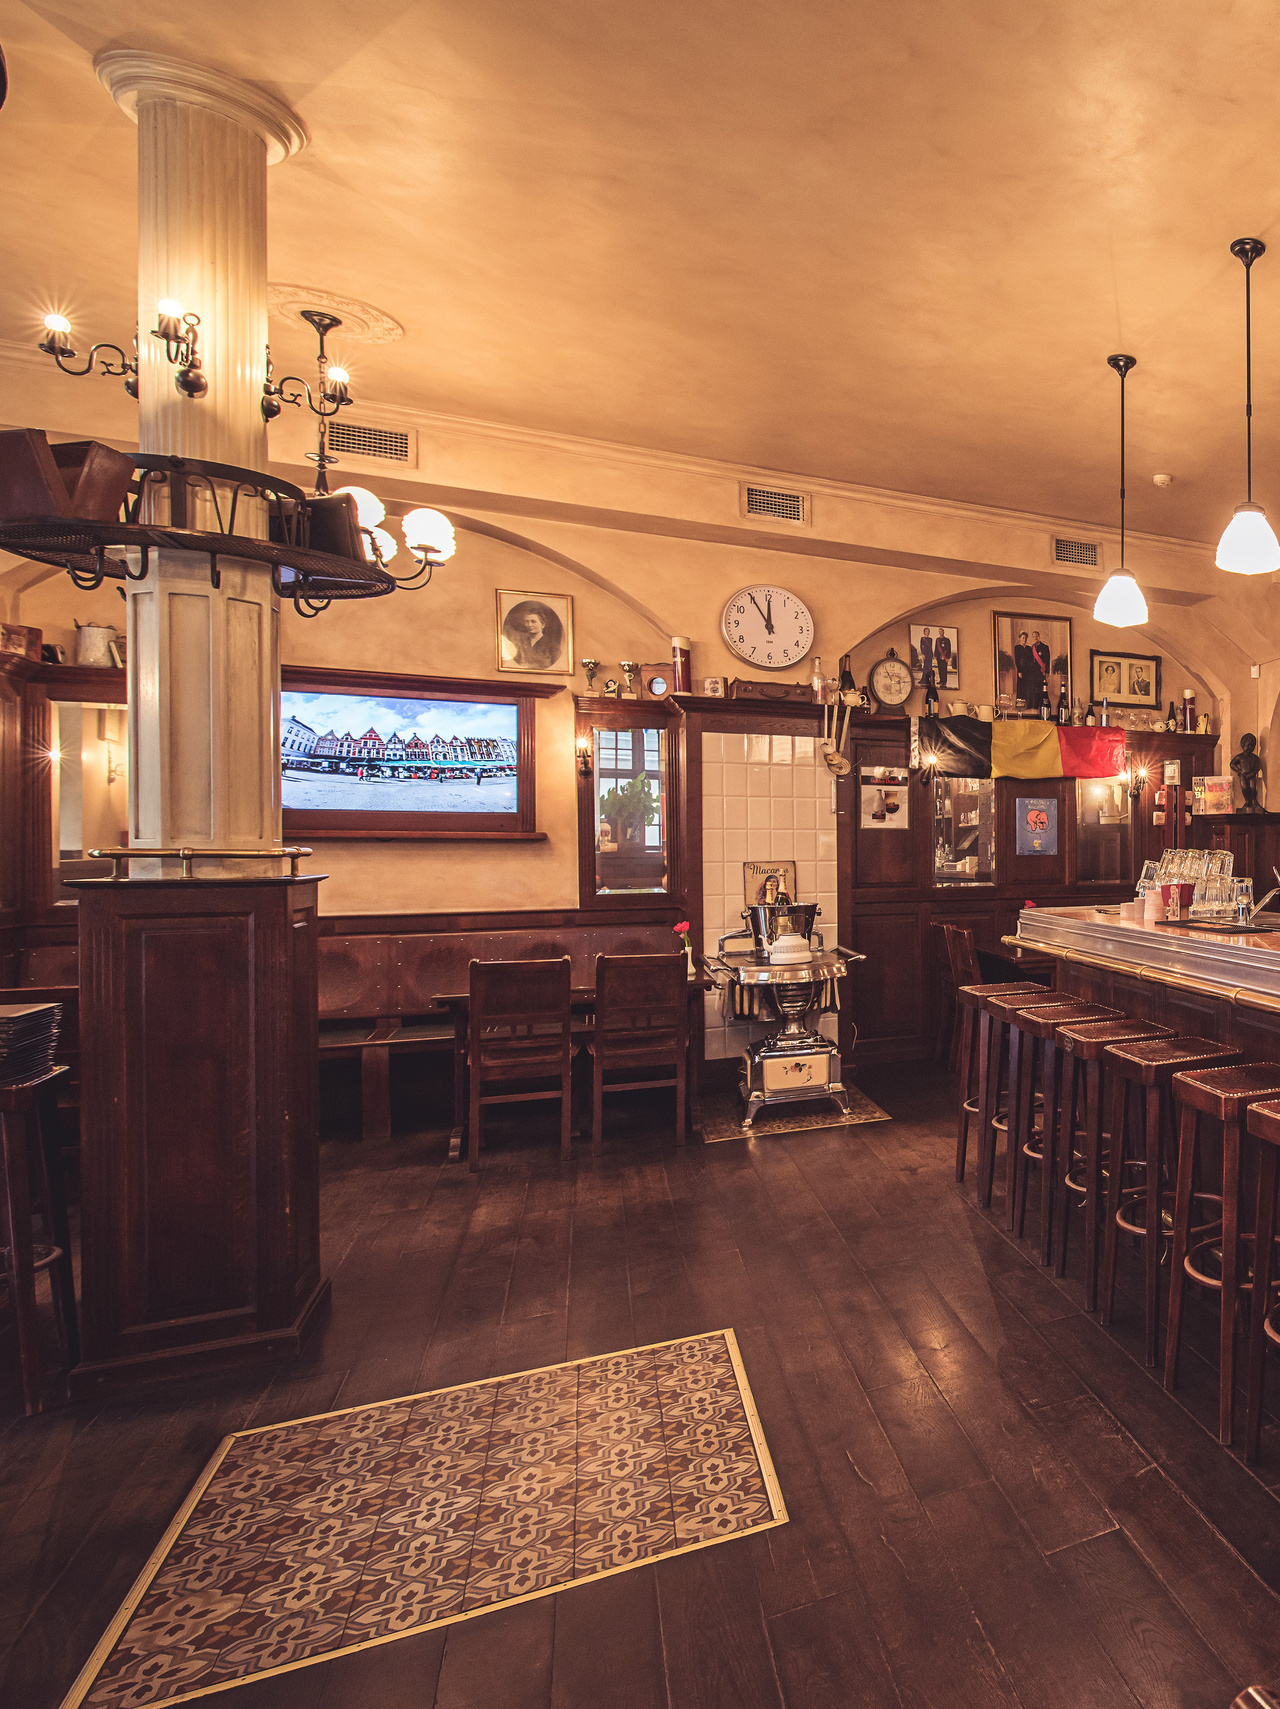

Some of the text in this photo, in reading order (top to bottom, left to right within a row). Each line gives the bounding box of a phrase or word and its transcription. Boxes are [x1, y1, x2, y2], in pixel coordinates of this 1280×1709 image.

[765, 593, 772, 602] 12
[736, 605, 745, 614] 10
[794, 611, 799, 619] 2
[734, 620, 739, 628] 9
[799, 626, 804, 634] 3
[738, 635, 744, 643] 8
[794, 640, 799, 648] 4
[751, 646, 756, 655] 7
[783, 649, 788, 657] 5
[767, 652, 772, 660] 6
